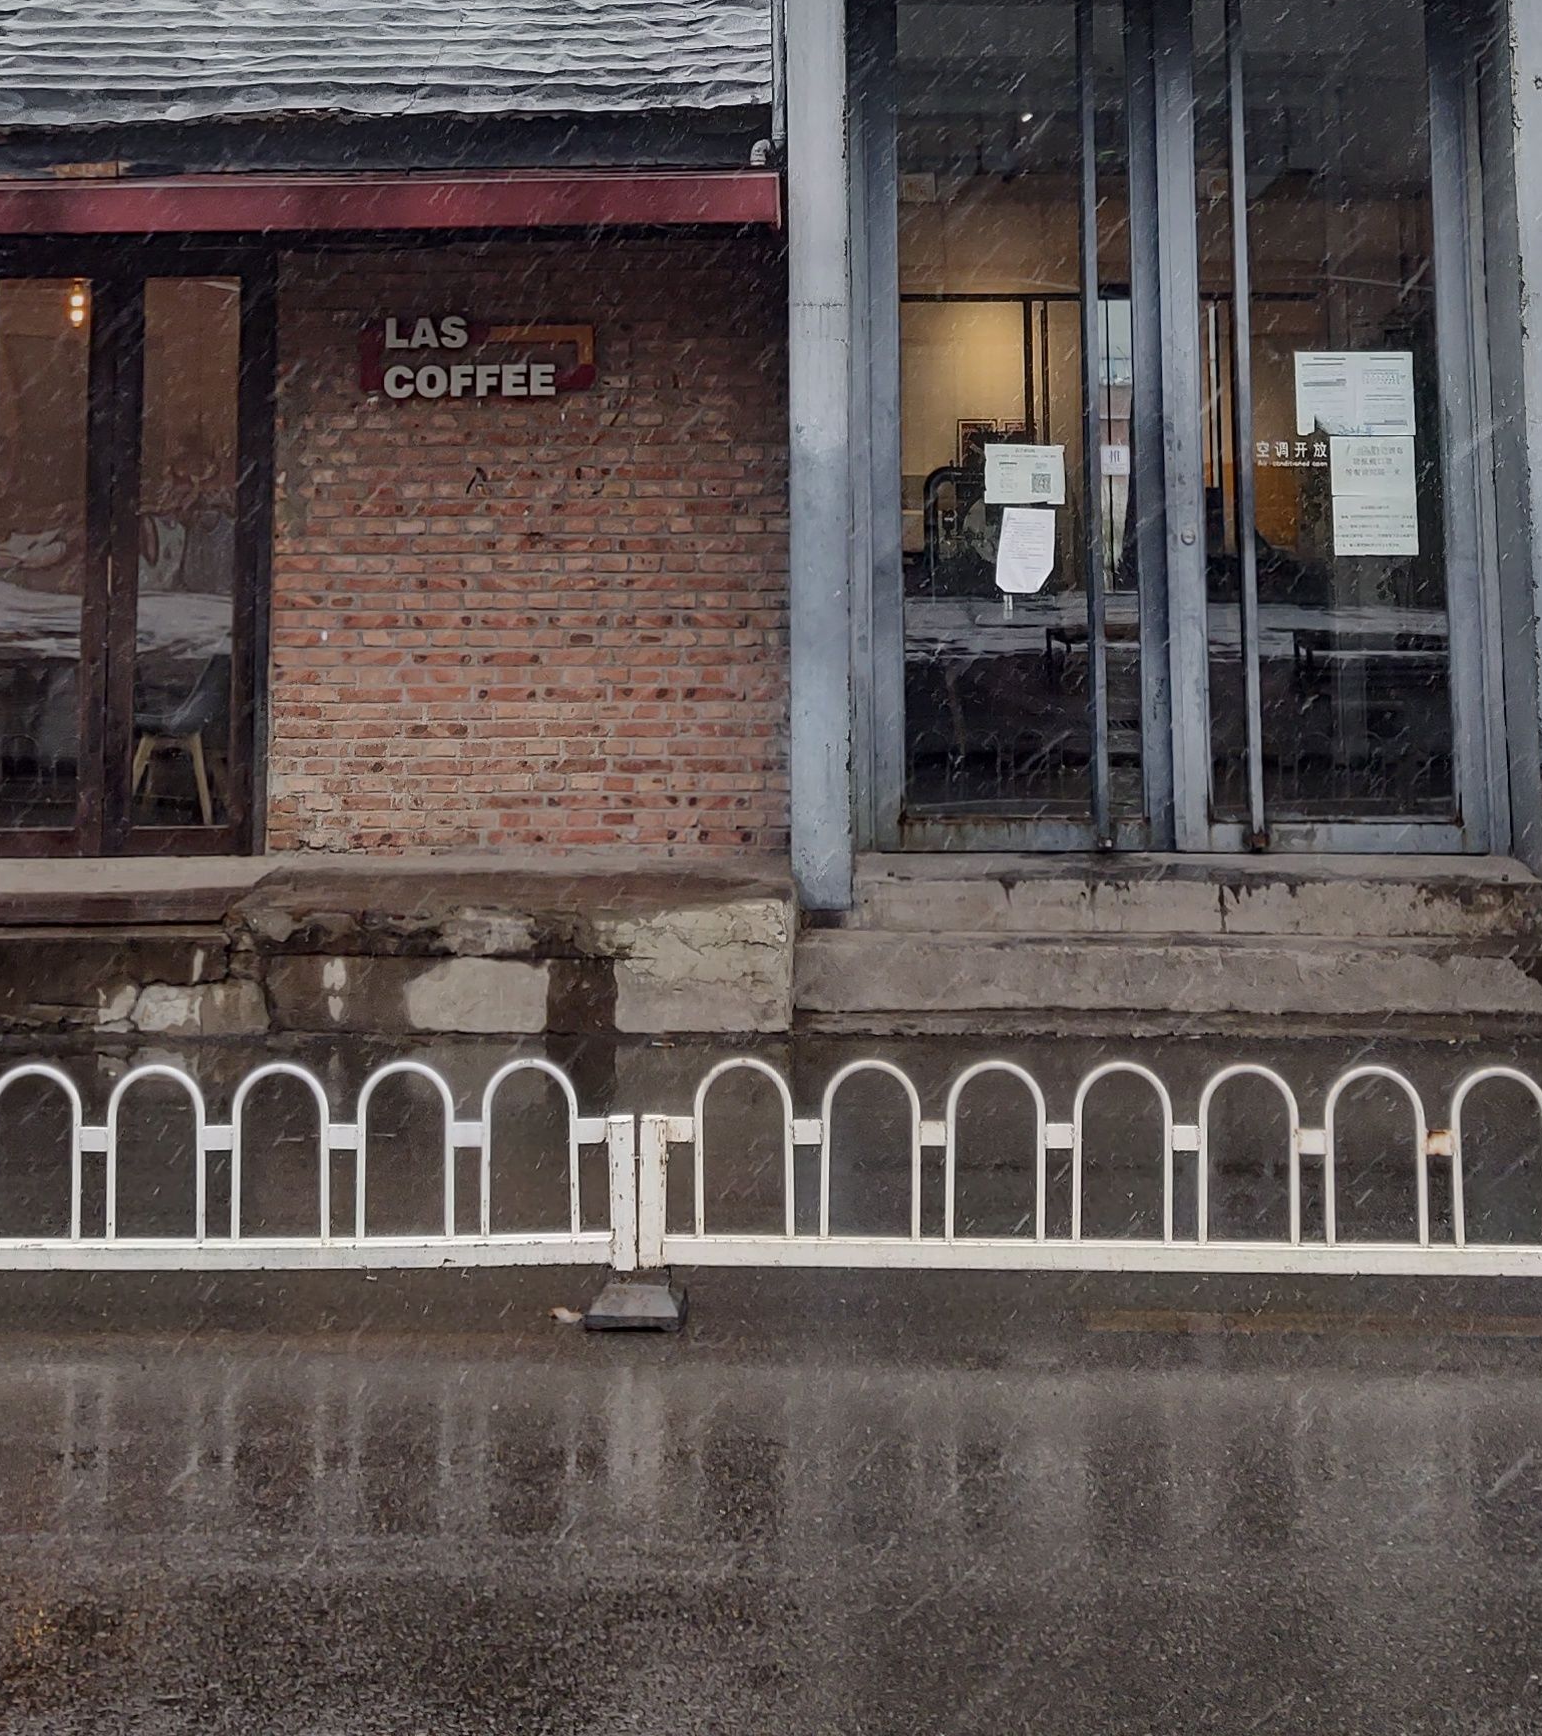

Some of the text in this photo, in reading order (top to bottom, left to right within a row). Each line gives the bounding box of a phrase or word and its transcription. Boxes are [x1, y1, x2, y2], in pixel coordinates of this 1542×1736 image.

[385, 316, 468, 349] LAS
[383, 363, 556, 398] COFFEE
[1256, 441, 1328, 459] 空调开放
